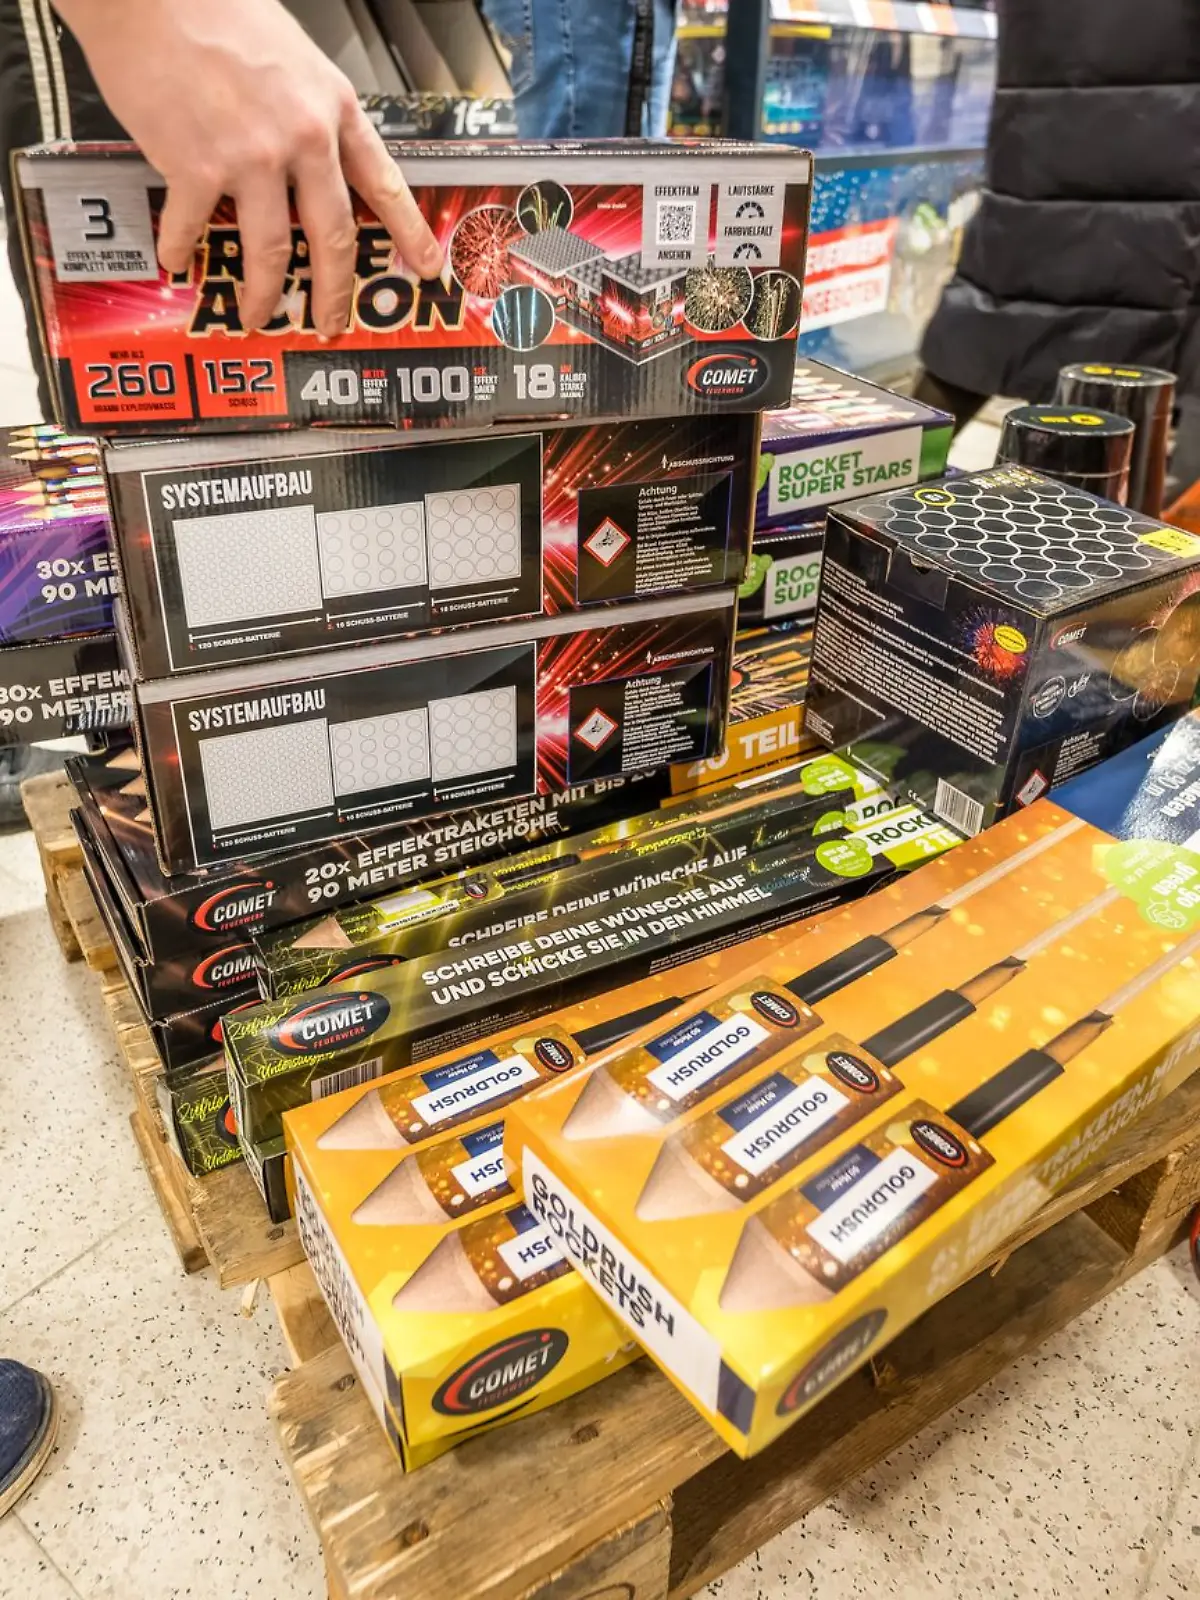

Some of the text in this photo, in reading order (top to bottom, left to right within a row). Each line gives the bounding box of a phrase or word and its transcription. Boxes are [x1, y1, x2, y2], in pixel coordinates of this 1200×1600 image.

[654, 185, 700, 197] EFFEKTFILM
[727, 184, 775, 197] LAUTSTÄRKE
[79, 196, 116, 242] 3
[723, 224, 774, 238] FARBVIELFALT
[656, 249, 692, 262] ANSEHEN
[85, 361, 177, 400] 260
[202, 358, 276, 395] 152
[301, 368, 359, 406] 40
[396, 366, 470, 404] 100
[513, 364, 557, 400] 18
[702, 367, 758, 387] COMET
[777, 450, 863, 484] ROCKET
[777, 458, 914, 503] SUPER STARS
[161, 470, 313, 510] SYSTEMAUFBAU
[638, 485, 678, 497] Achtung
[36, 559, 87, 581] 30x
[41, 583, 77, 604] 90
[624, 676, 662, 690] Achtung
[0, 705, 33, 726] 90
[187, 687, 328, 733] SYSTEMAUFBAU
[738, 720, 800, 760] TEIL
[304, 859, 351, 885] 20x
[356, 795, 548, 869] EFFEKTRAKETEN
[551, 787, 588, 807] MIT
[307, 810, 559, 904] 90 METER STEIGHÖHE
[213, 889, 277, 924] COMET
[421, 940, 536, 987] SCHREIBE
[537, 921, 600, 951] DEINE
[600, 886, 709, 931] WÜNSCHE
[708, 874, 748, 899] AUF
[431, 885, 773, 1006] UND SCHICKE SIE IN DEN HIMMEL
[302, 1000, 375, 1041] COMET
[312, 1026, 367, 1050] FEUERWERK
[667, 1025, 751, 1087] GOLDRUSH
[429, 1065, 523, 1113] GOLDRUSH
[744, 1090, 829, 1160] GOLDRUSH
[829, 1166, 916, 1243] GOLDRUSH
[531, 1172, 676, 1338] GOLDRUSH
[532, 1192, 646, 1330] ROCKETS
[468, 1342, 554, 1401] COMET
